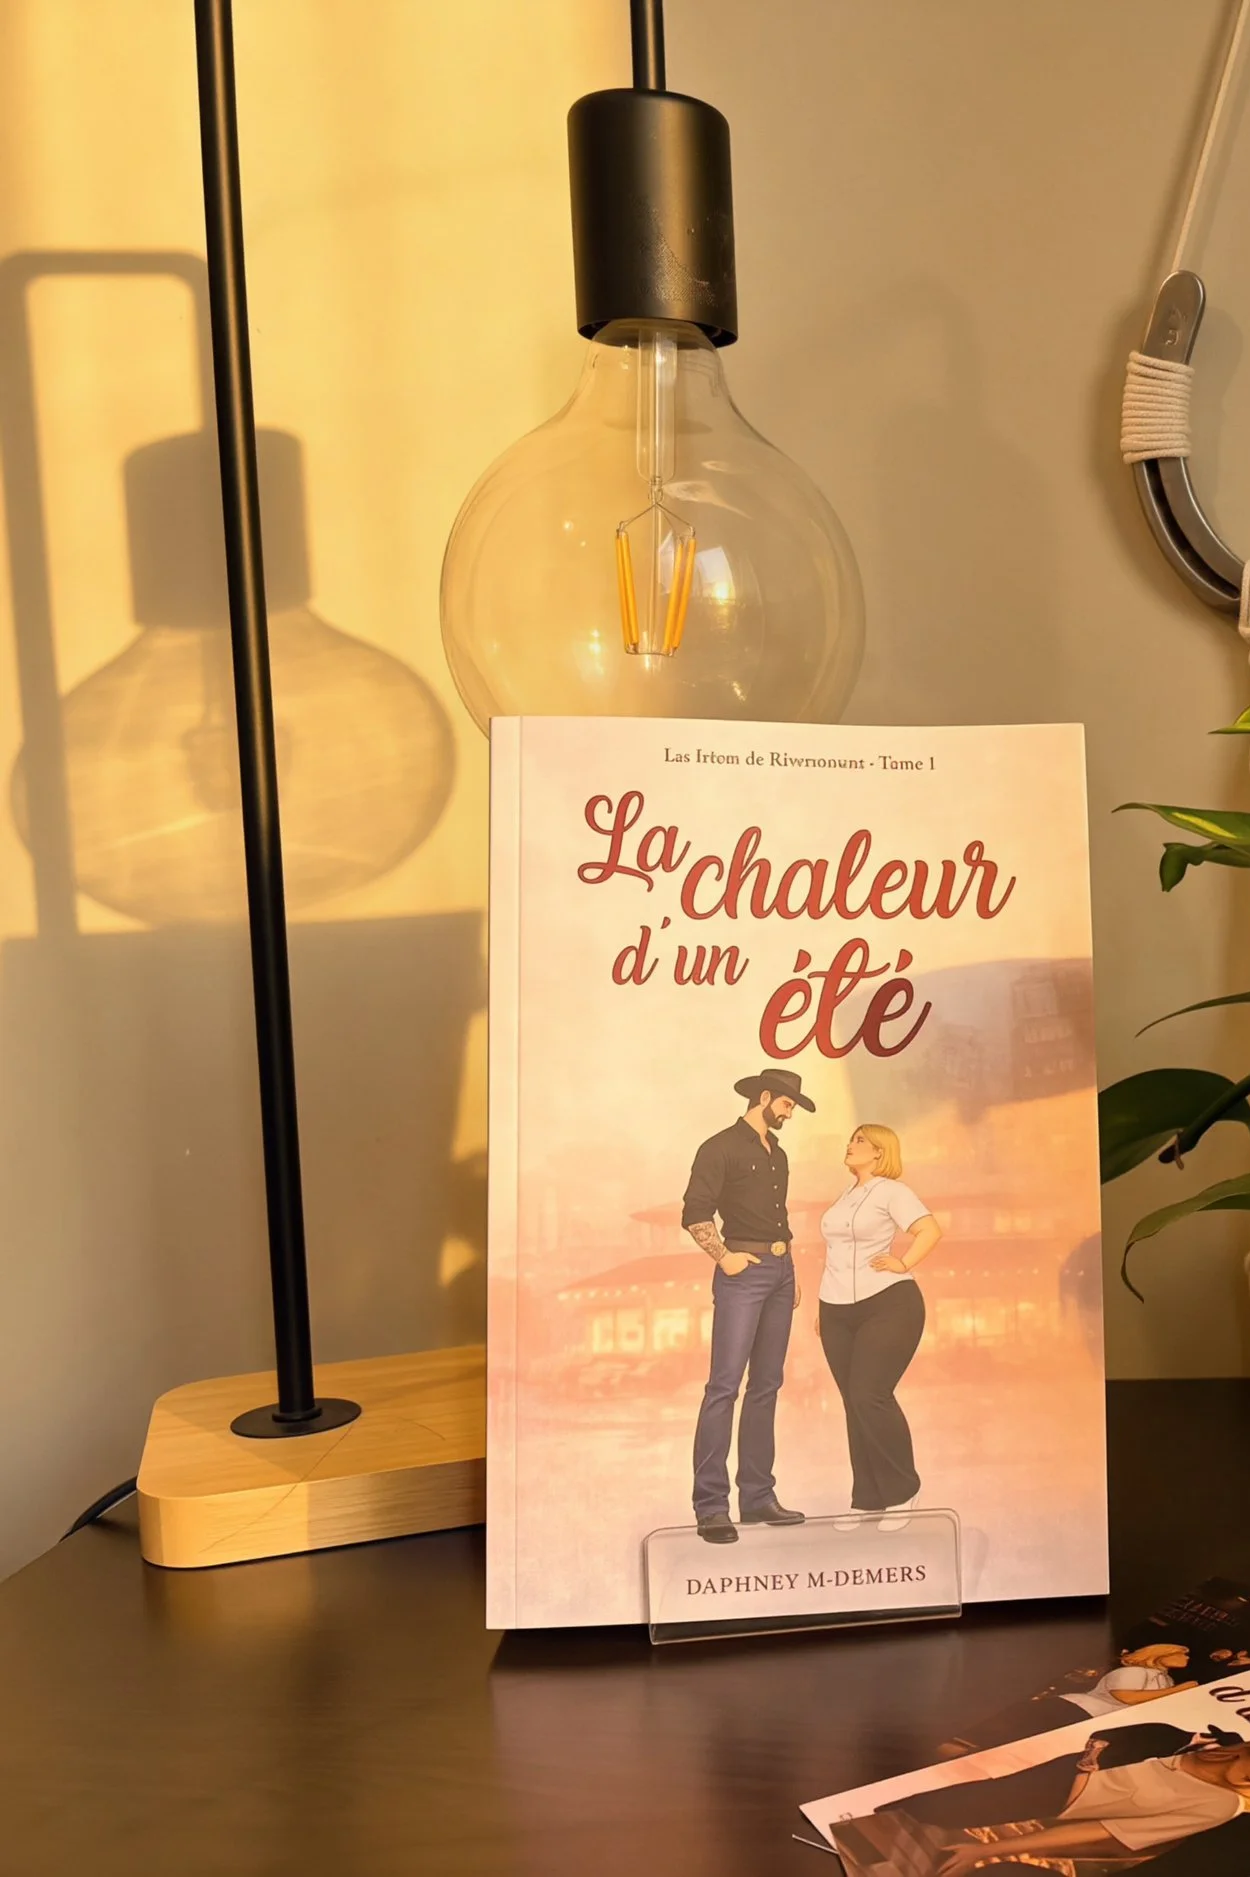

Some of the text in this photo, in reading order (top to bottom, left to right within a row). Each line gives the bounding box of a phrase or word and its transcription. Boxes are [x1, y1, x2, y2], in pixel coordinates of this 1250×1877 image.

[745, 750, 764, 766] de
[577, 790, 1017, 920] La chaleur
[611, 916, 932, 1061] d'un été
[686, 1564, 926, 1596] DAPHNEY M-DEMERS
